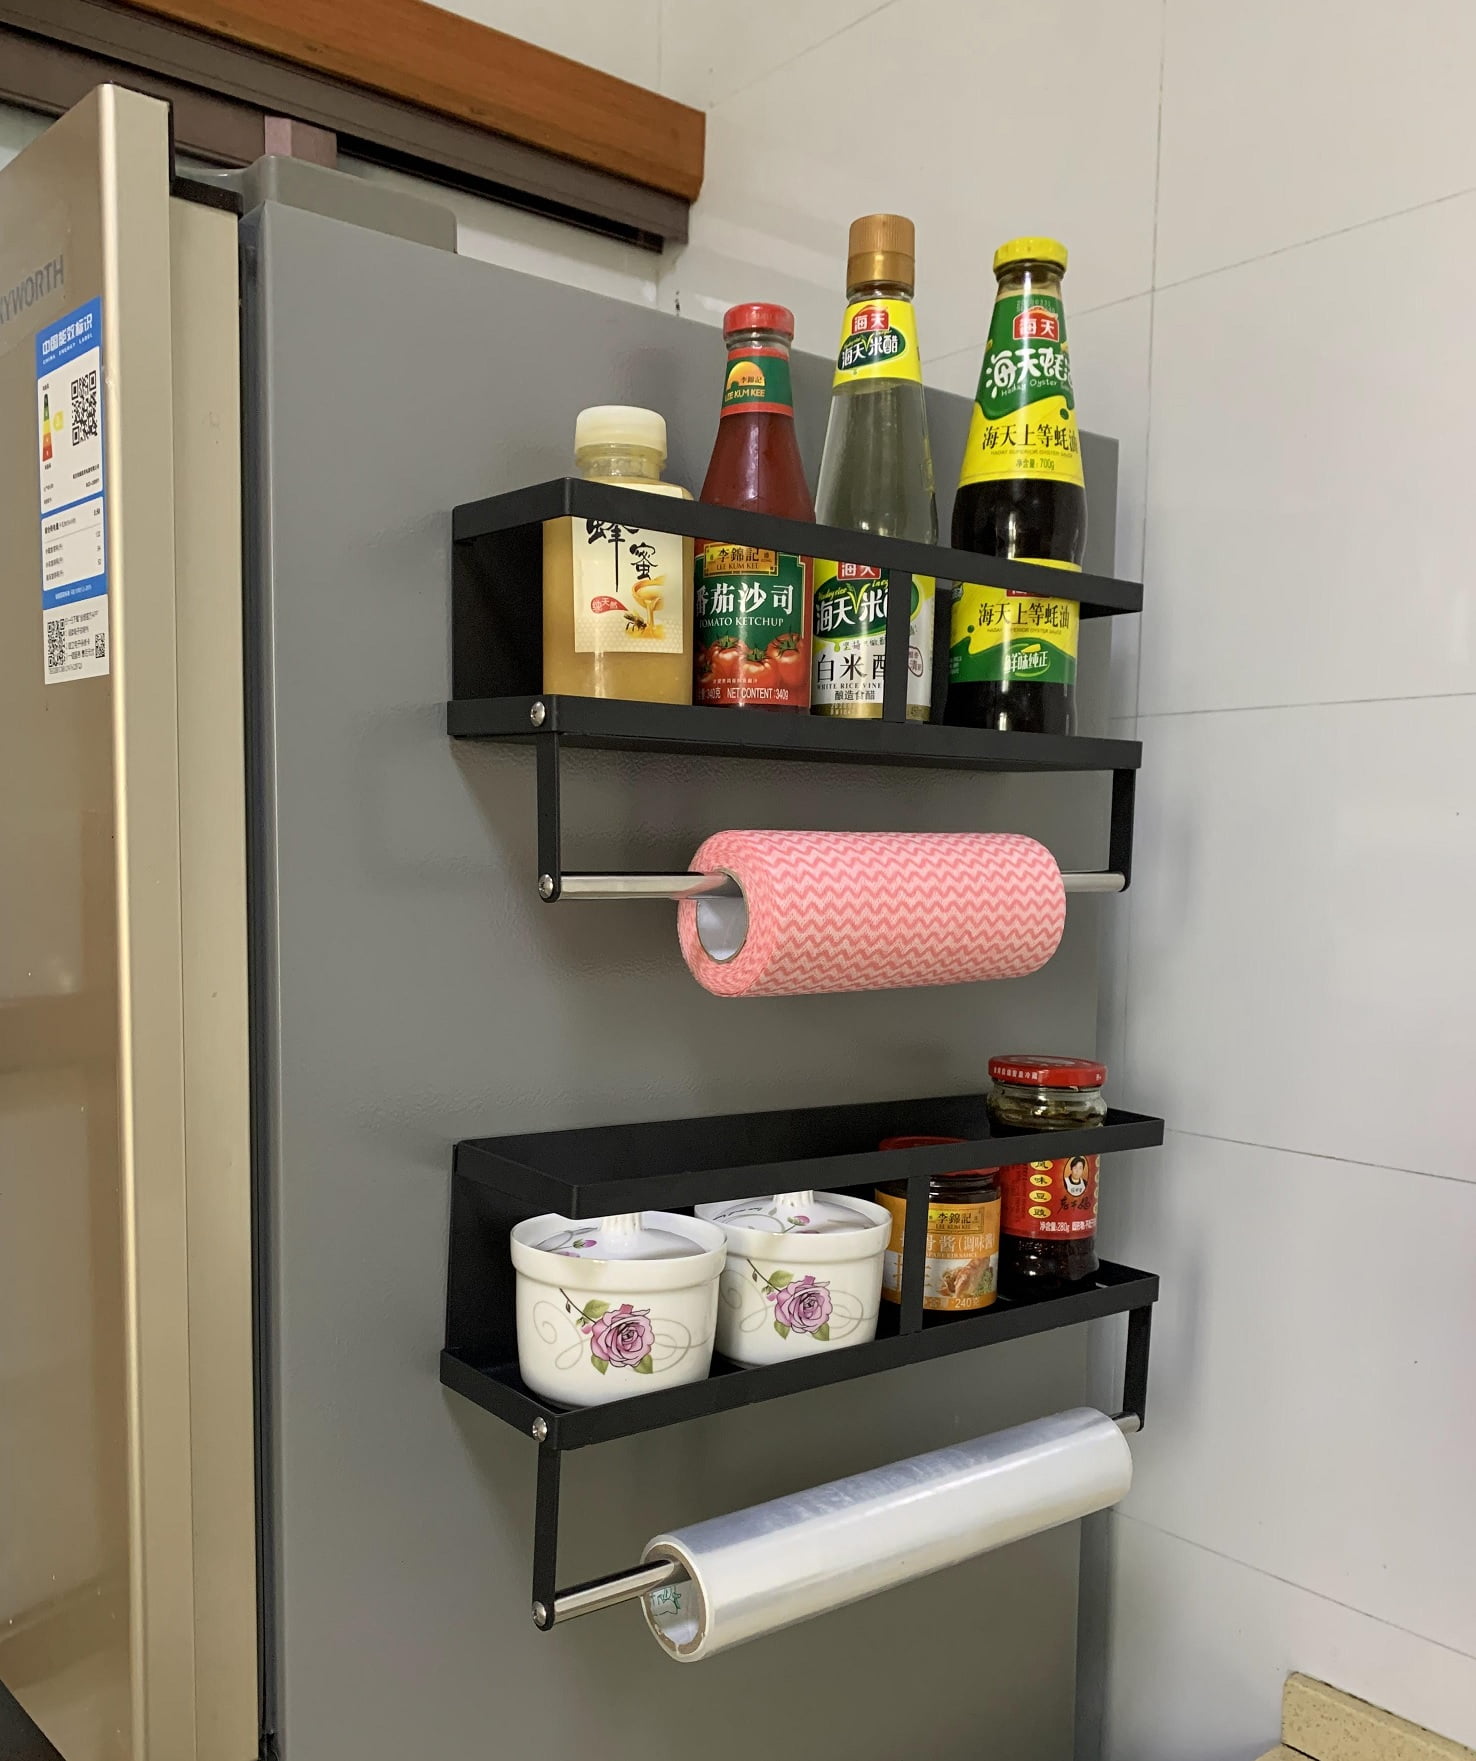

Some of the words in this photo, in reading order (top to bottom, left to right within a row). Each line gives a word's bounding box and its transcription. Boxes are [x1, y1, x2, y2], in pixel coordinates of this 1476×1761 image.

[854, 312, 885, 332] 海天
[1019, 319, 1055, 338] 海天
[1029, 378, 1058, 388] Oyster
[750, 389, 765, 397] KEE
[816, 589, 889, 635] 海天米
[978, 602, 1070, 630] 海天上等蚝油
[735, 616, 784, 628] KETCHUP
[727, 688, 740, 699] NET
